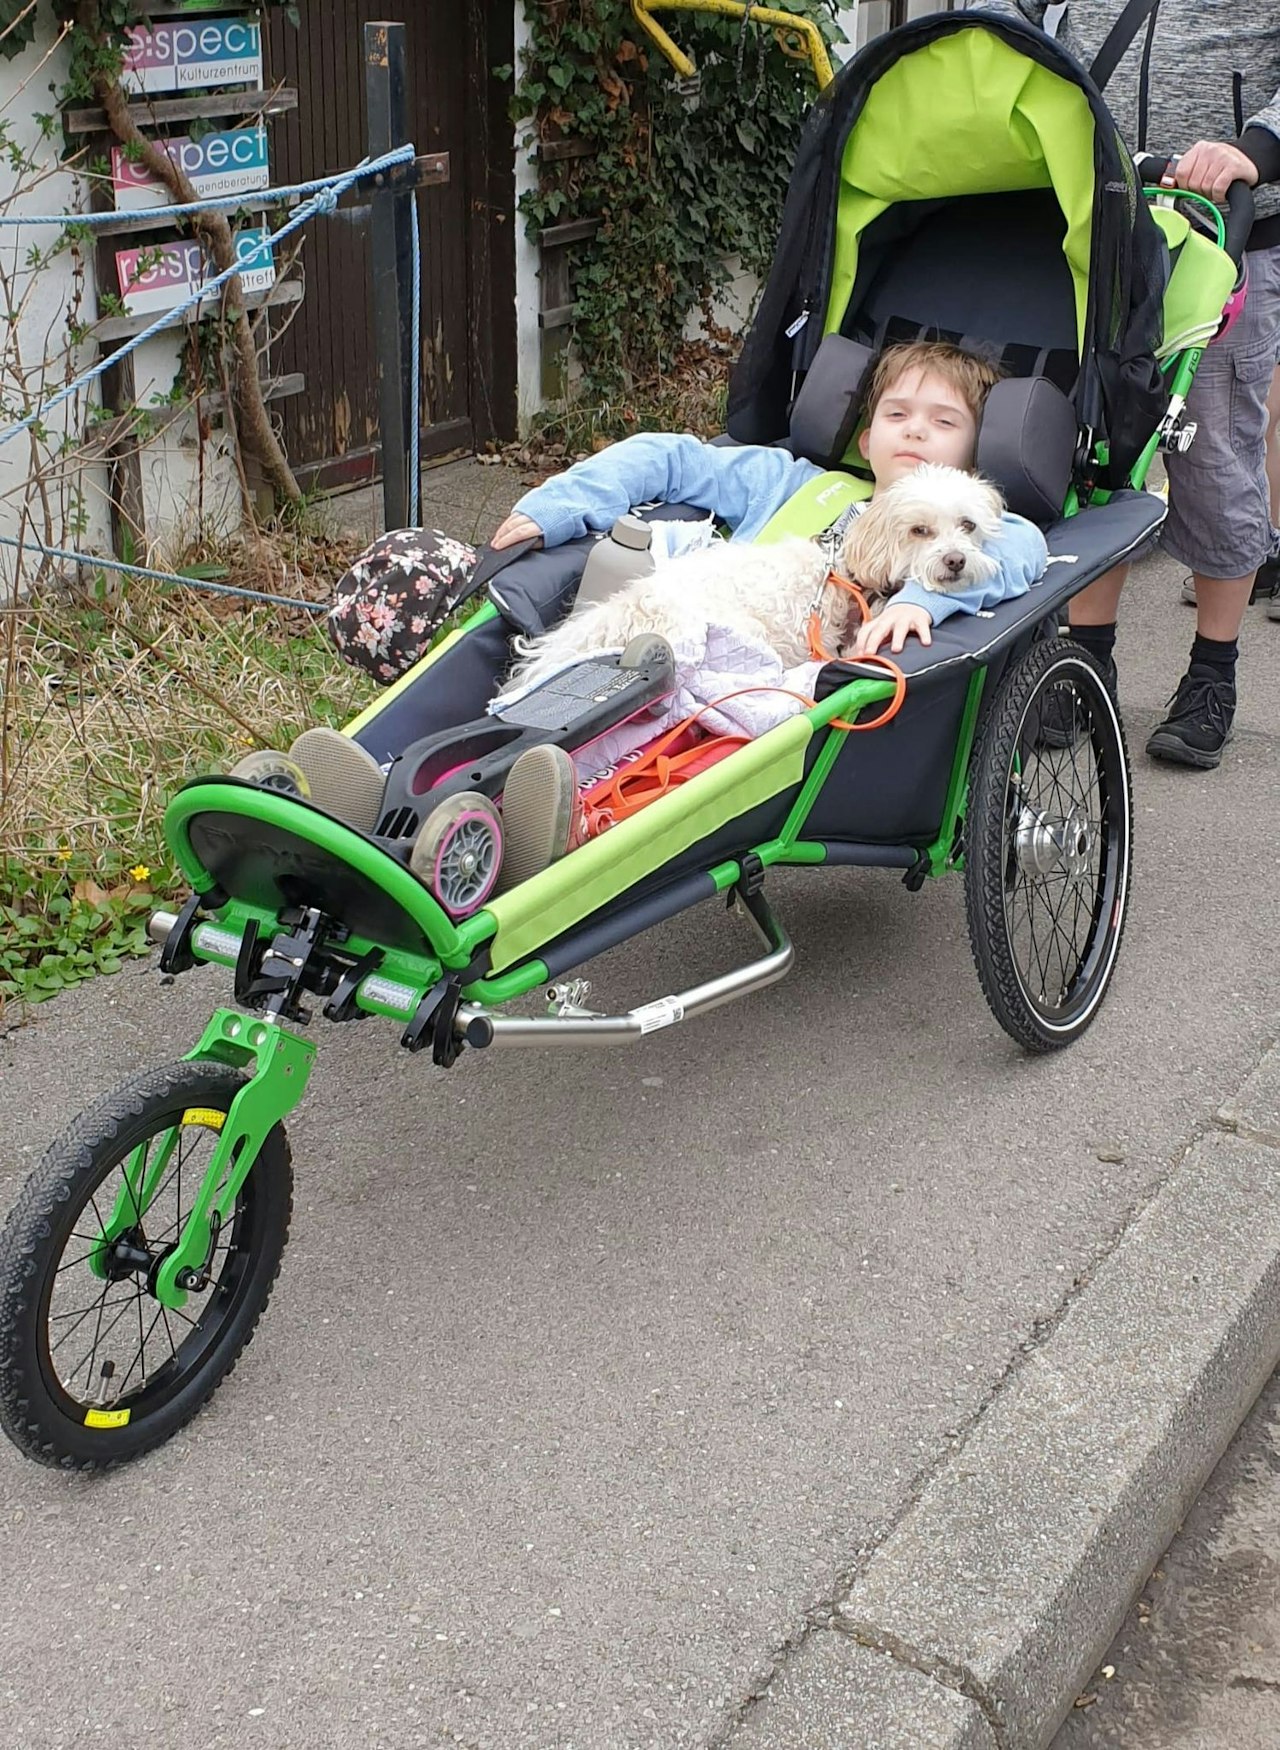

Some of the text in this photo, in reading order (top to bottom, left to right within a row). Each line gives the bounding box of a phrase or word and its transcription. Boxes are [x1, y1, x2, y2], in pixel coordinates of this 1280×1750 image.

[180, 65, 259, 81] Kulturzentrum
[116, 131, 267, 180] rpect
[195, 174, 268, 194] gendberatung
